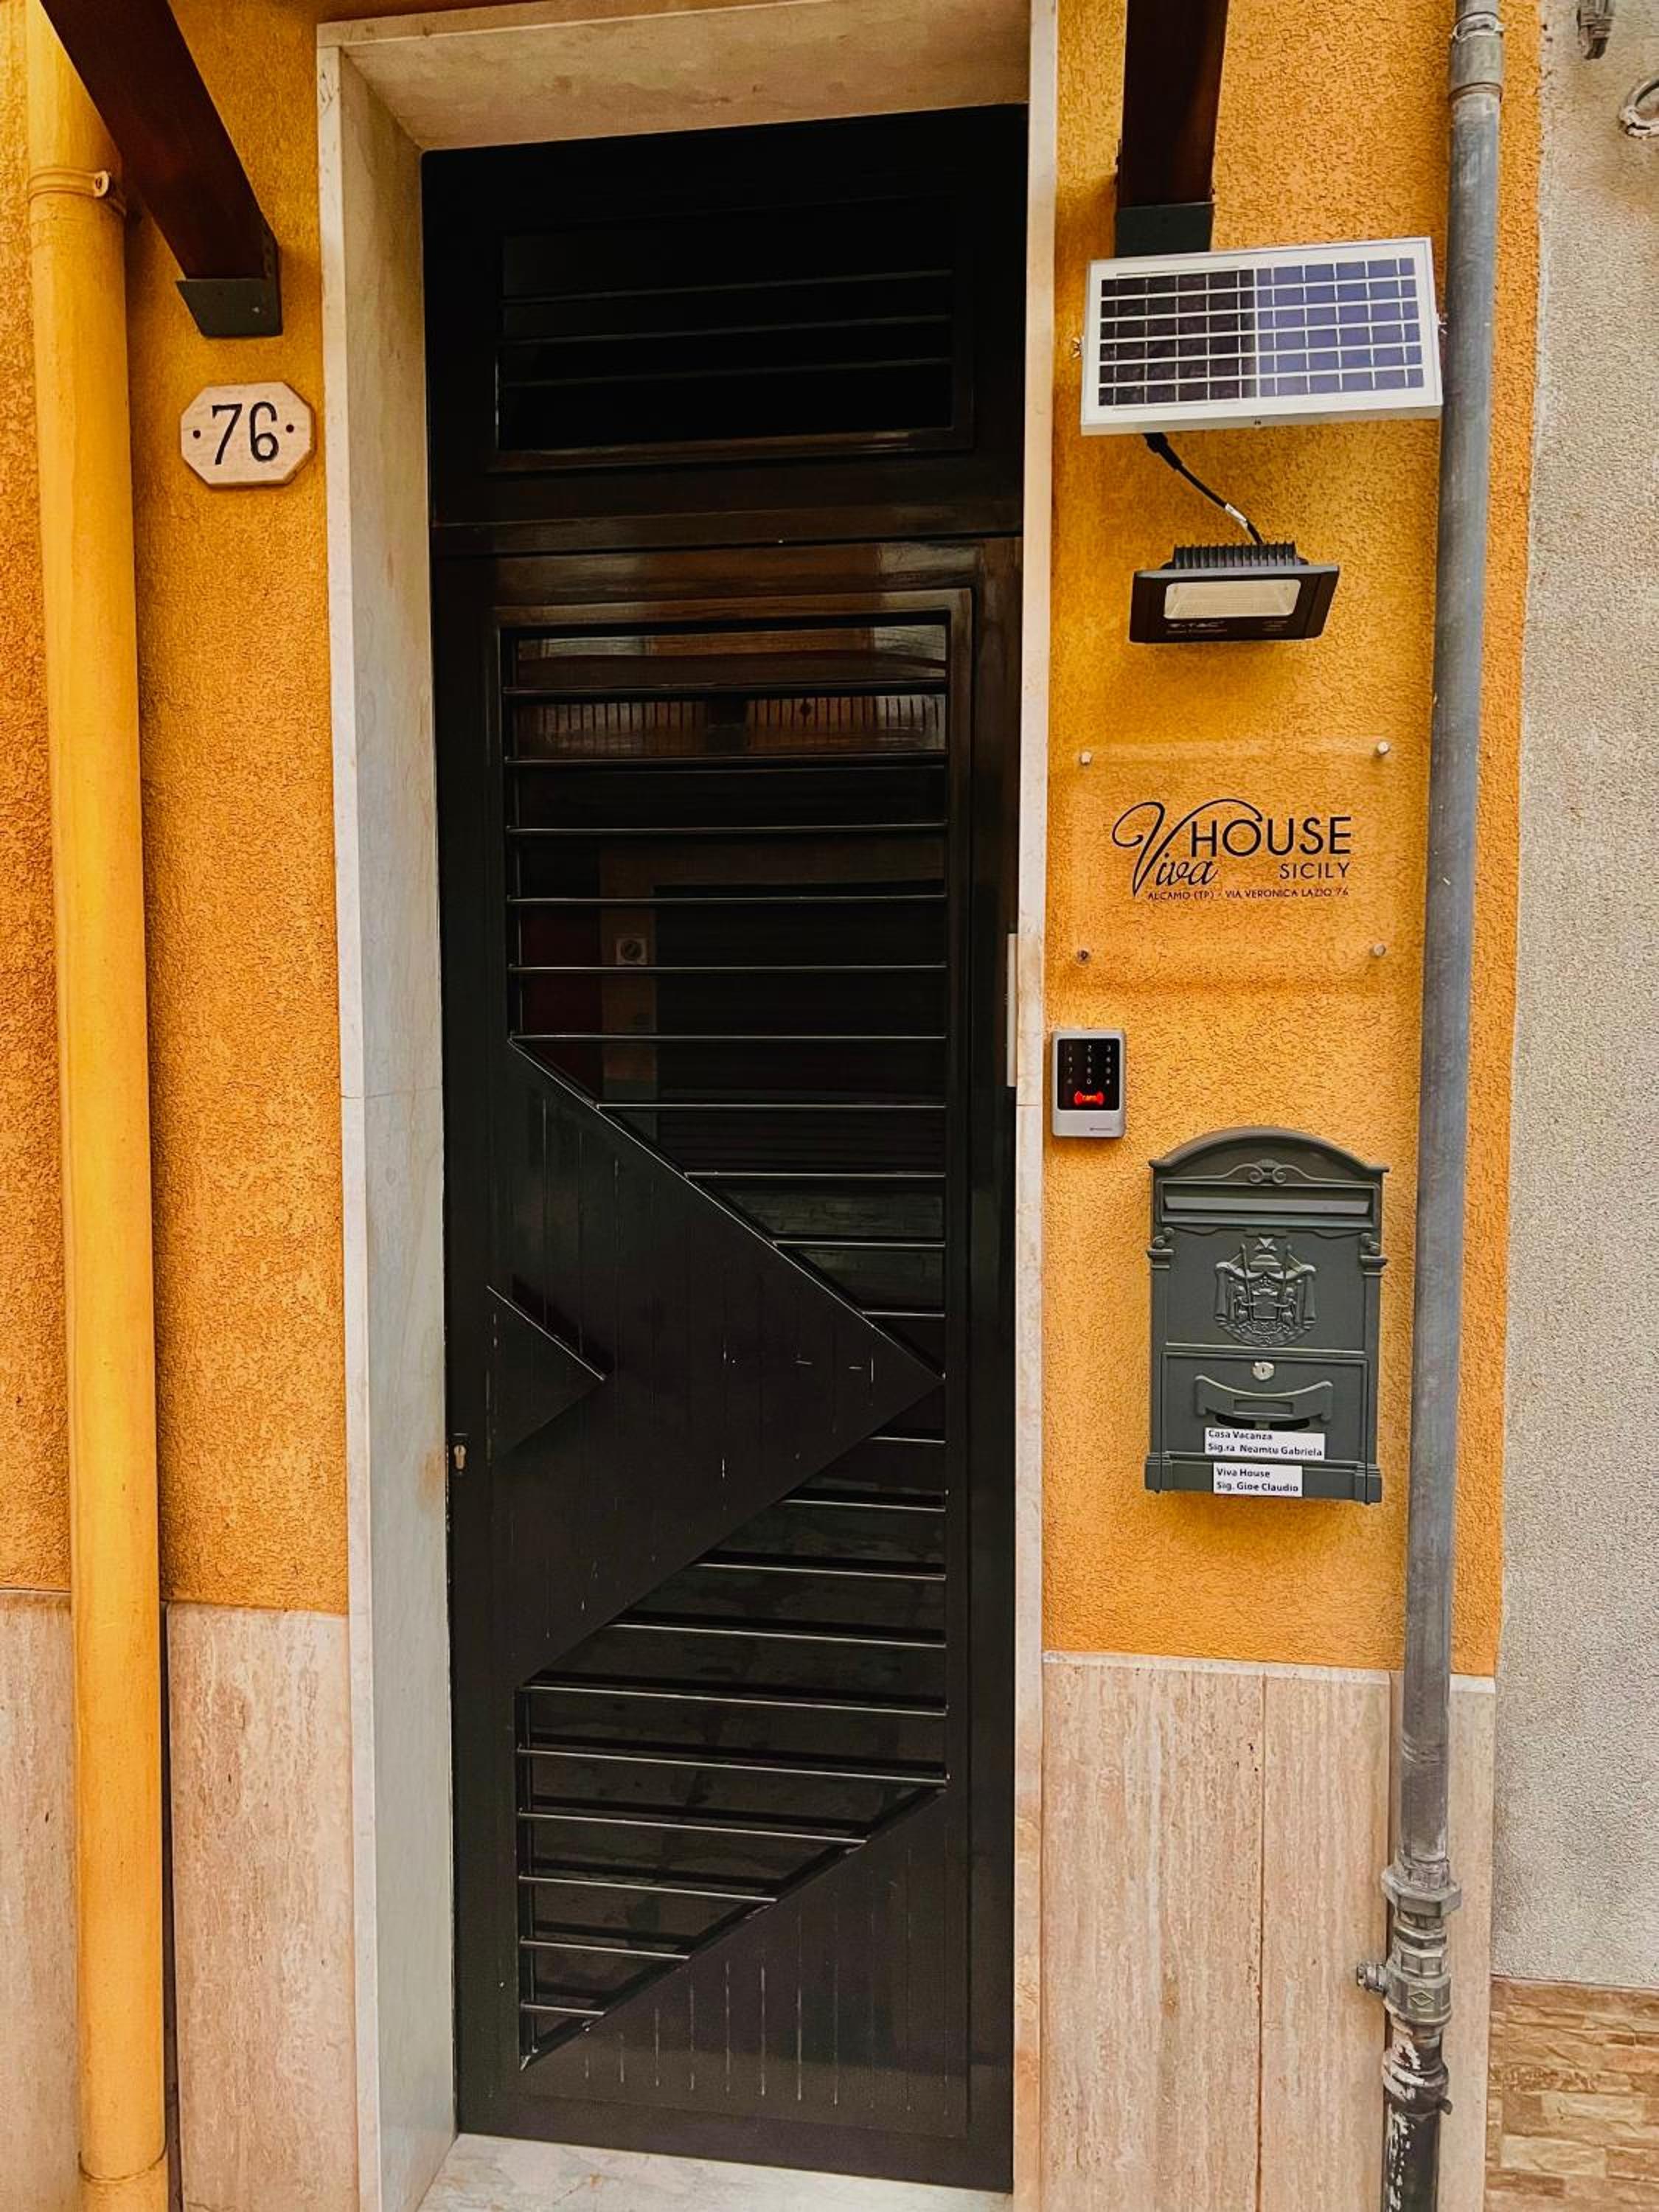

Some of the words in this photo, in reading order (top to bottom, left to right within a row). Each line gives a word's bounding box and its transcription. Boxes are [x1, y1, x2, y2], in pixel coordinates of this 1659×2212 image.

[212, 401, 279, 465] 76
[1112, 799, 1263, 897] Viva
[1191, 815, 1352, 858] HOUSE
[1279, 862, 1351, 880] SICILY
[1147, 891, 1191, 900] ALCAMO
[1225, 889, 1242, 899] VIA
[1245, 888, 1298, 898] VERONICA
[1208, 1430, 1231, 1439] Casa
[1233, 1431, 1273, 1440] Vacanza
[1208, 1443, 1235, 1453] Sig.ra
[1239, 1444, 1279, 1454] Neamtu
[1281, 1447, 1322, 1456] Gabriela
[1217, 1468, 1238, 1477] Viva
[1239, 1469, 1270, 1478] House
[1217, 1481, 1235, 1491] Sig.
[1237, 1482, 1259, 1490] Gioe
[1262, 1483, 1298, 1492] Claudio
